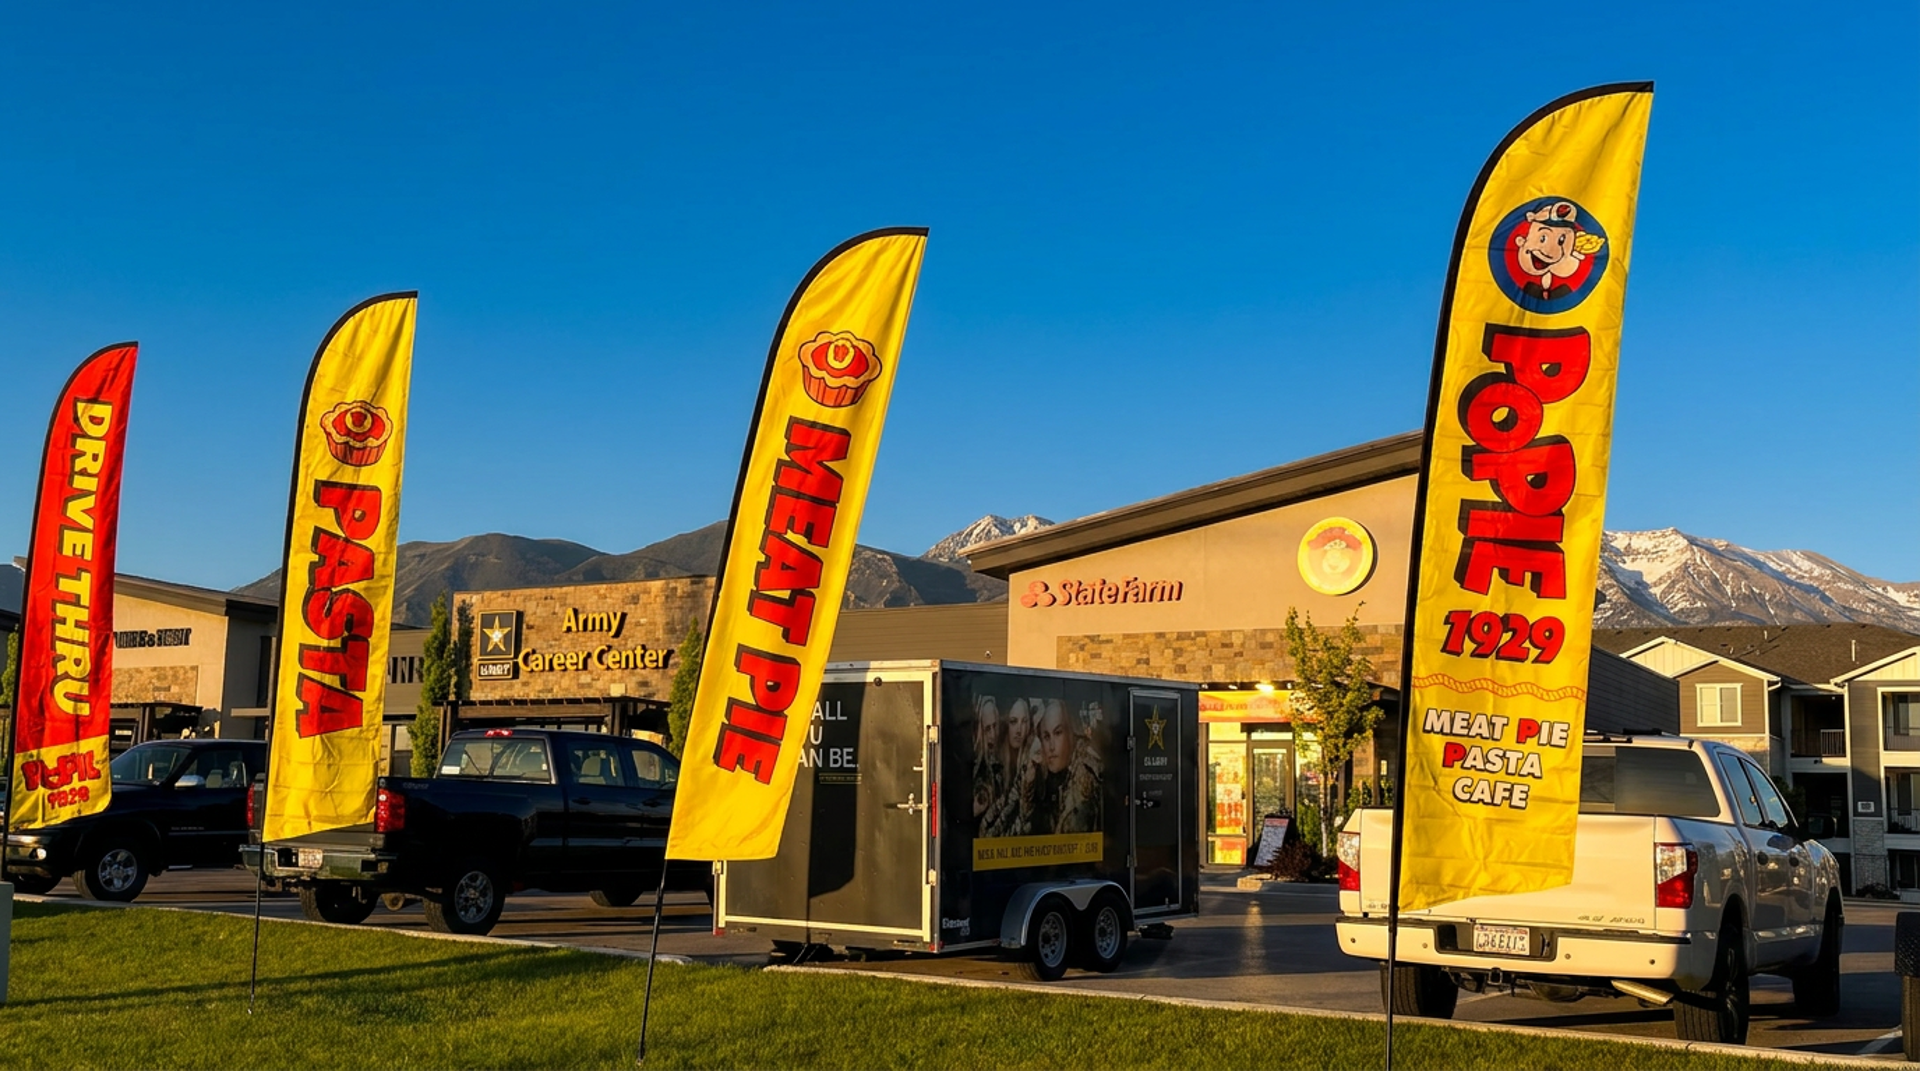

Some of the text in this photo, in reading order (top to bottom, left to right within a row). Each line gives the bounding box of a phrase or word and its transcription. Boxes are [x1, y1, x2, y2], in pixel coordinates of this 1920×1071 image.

[1454, 322, 1591, 600] POPIE
[53, 397, 113, 717] DRIVE THRU
[296, 479, 383, 739] PASTA
[713, 415, 852, 786] MEAT PIE
[562, 607, 625, 638] Army
[1441, 610, 1566, 664] 1929
[518, 647, 591, 672] Career
[593, 644, 670, 670] Center
[811, 700, 848, 721] ALL
[1422, 708, 1570, 748] MEAT PIE
[829, 747, 860, 768] BE.
[1442, 742, 1543, 780] PASTA
[1452, 775, 1531, 810] CAFE
